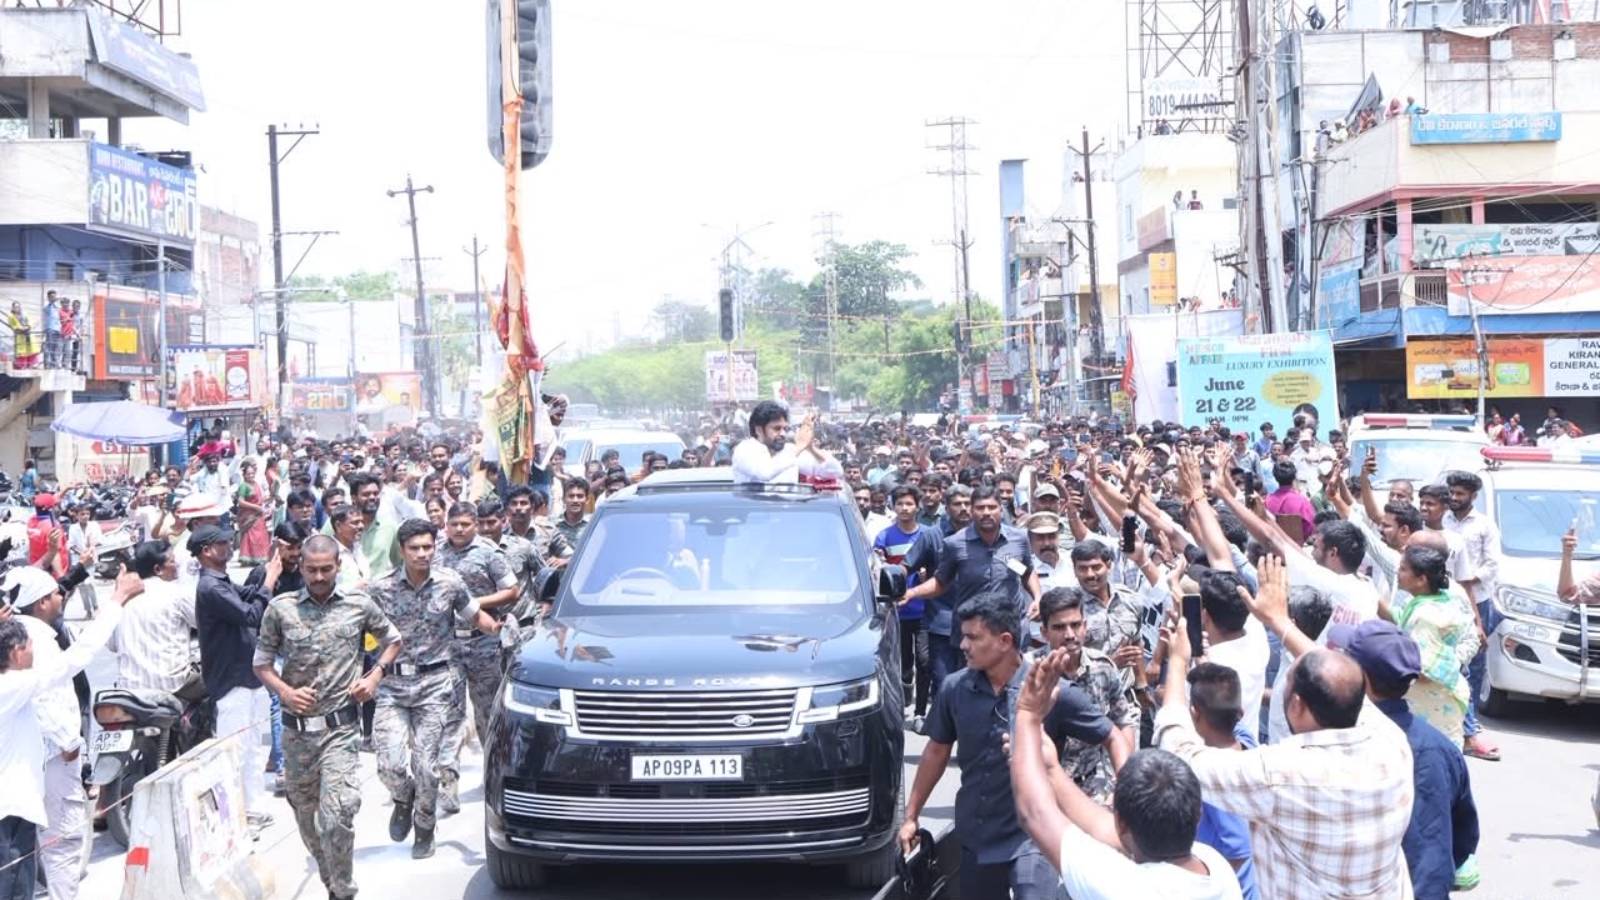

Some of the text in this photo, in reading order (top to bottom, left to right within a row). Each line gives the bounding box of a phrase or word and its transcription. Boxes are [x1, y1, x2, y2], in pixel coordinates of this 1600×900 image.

[1149, 94, 1175, 116] 8019
[109, 173, 150, 229] BAR
[1226, 356, 1327, 371] LUXURY EXHIBITION
[1549, 360, 1599, 370] GENERAL
[1204, 377, 1245, 392] June
[1582, 381, 1589, 391] &
[1196, 396, 1257, 413] 21 & 22
[592, 677, 675, 686] RANGE
[95, 732, 111, 743] AP
[643, 759, 738, 776] AP09PA 113
